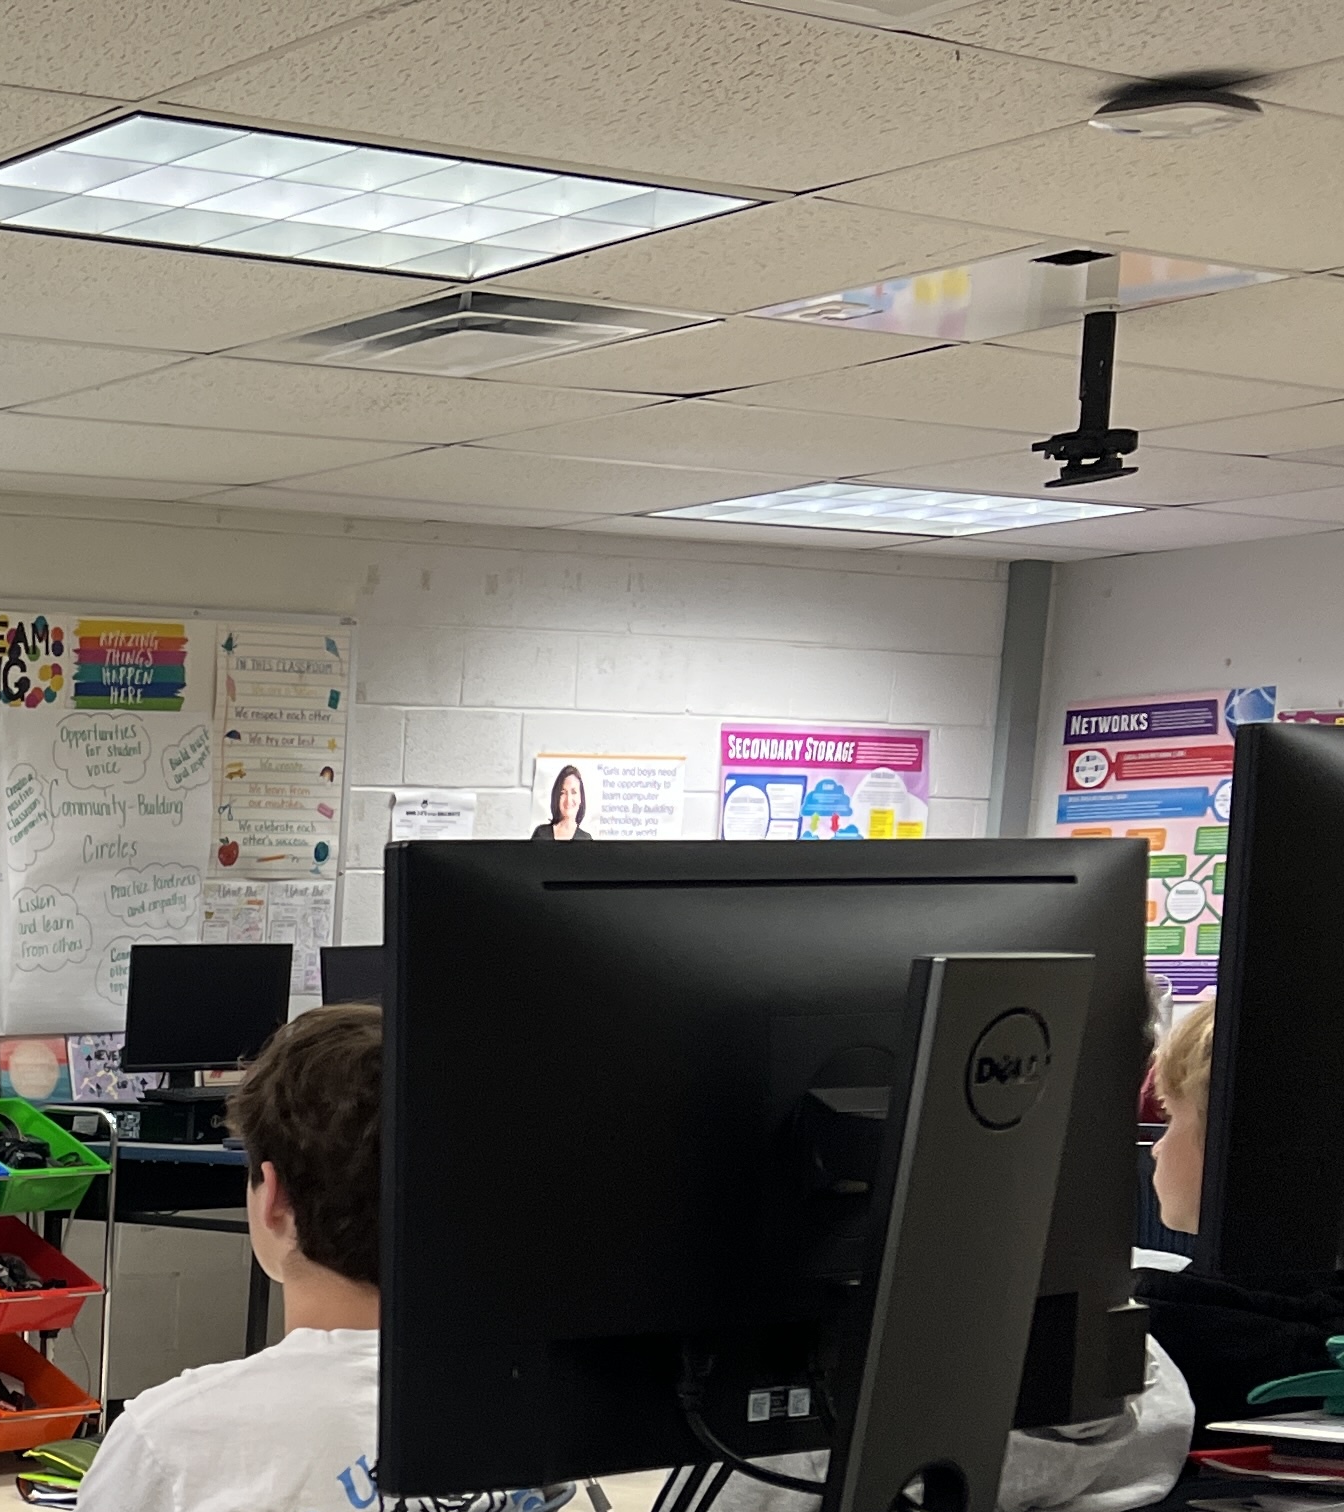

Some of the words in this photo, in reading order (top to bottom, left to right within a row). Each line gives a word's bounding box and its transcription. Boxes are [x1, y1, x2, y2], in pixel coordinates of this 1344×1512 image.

[100, 630, 159, 648] AMAZING
[105, 649, 154, 667] THINGS
[102, 667, 153, 685] HAPPEN
[110, 686, 143, 704] HERE
[235, 706, 248, 719] We
[251, 707, 284, 722] respect
[286, 709, 305, 721] each
[1070, 712, 1148, 735] NETWORKS
[60, 723, 137, 749] Opportunities
[249, 733, 262, 745] We
[282, 735, 295, 745] our
[86, 742, 100, 757] for
[107, 742, 141, 757] student
[728, 734, 804, 761] SECONDARY
[805, 737, 855, 763] STORAGE
[253, 820, 294, 833] celebrate
[83, 834, 137, 863] Circles
[18, 895, 56, 913] Listen
[18, 918, 36, 935] and
[43, 915, 74, 931] learn
[21, 942, 49, 958] from
[53, 938, 82, 953] others
